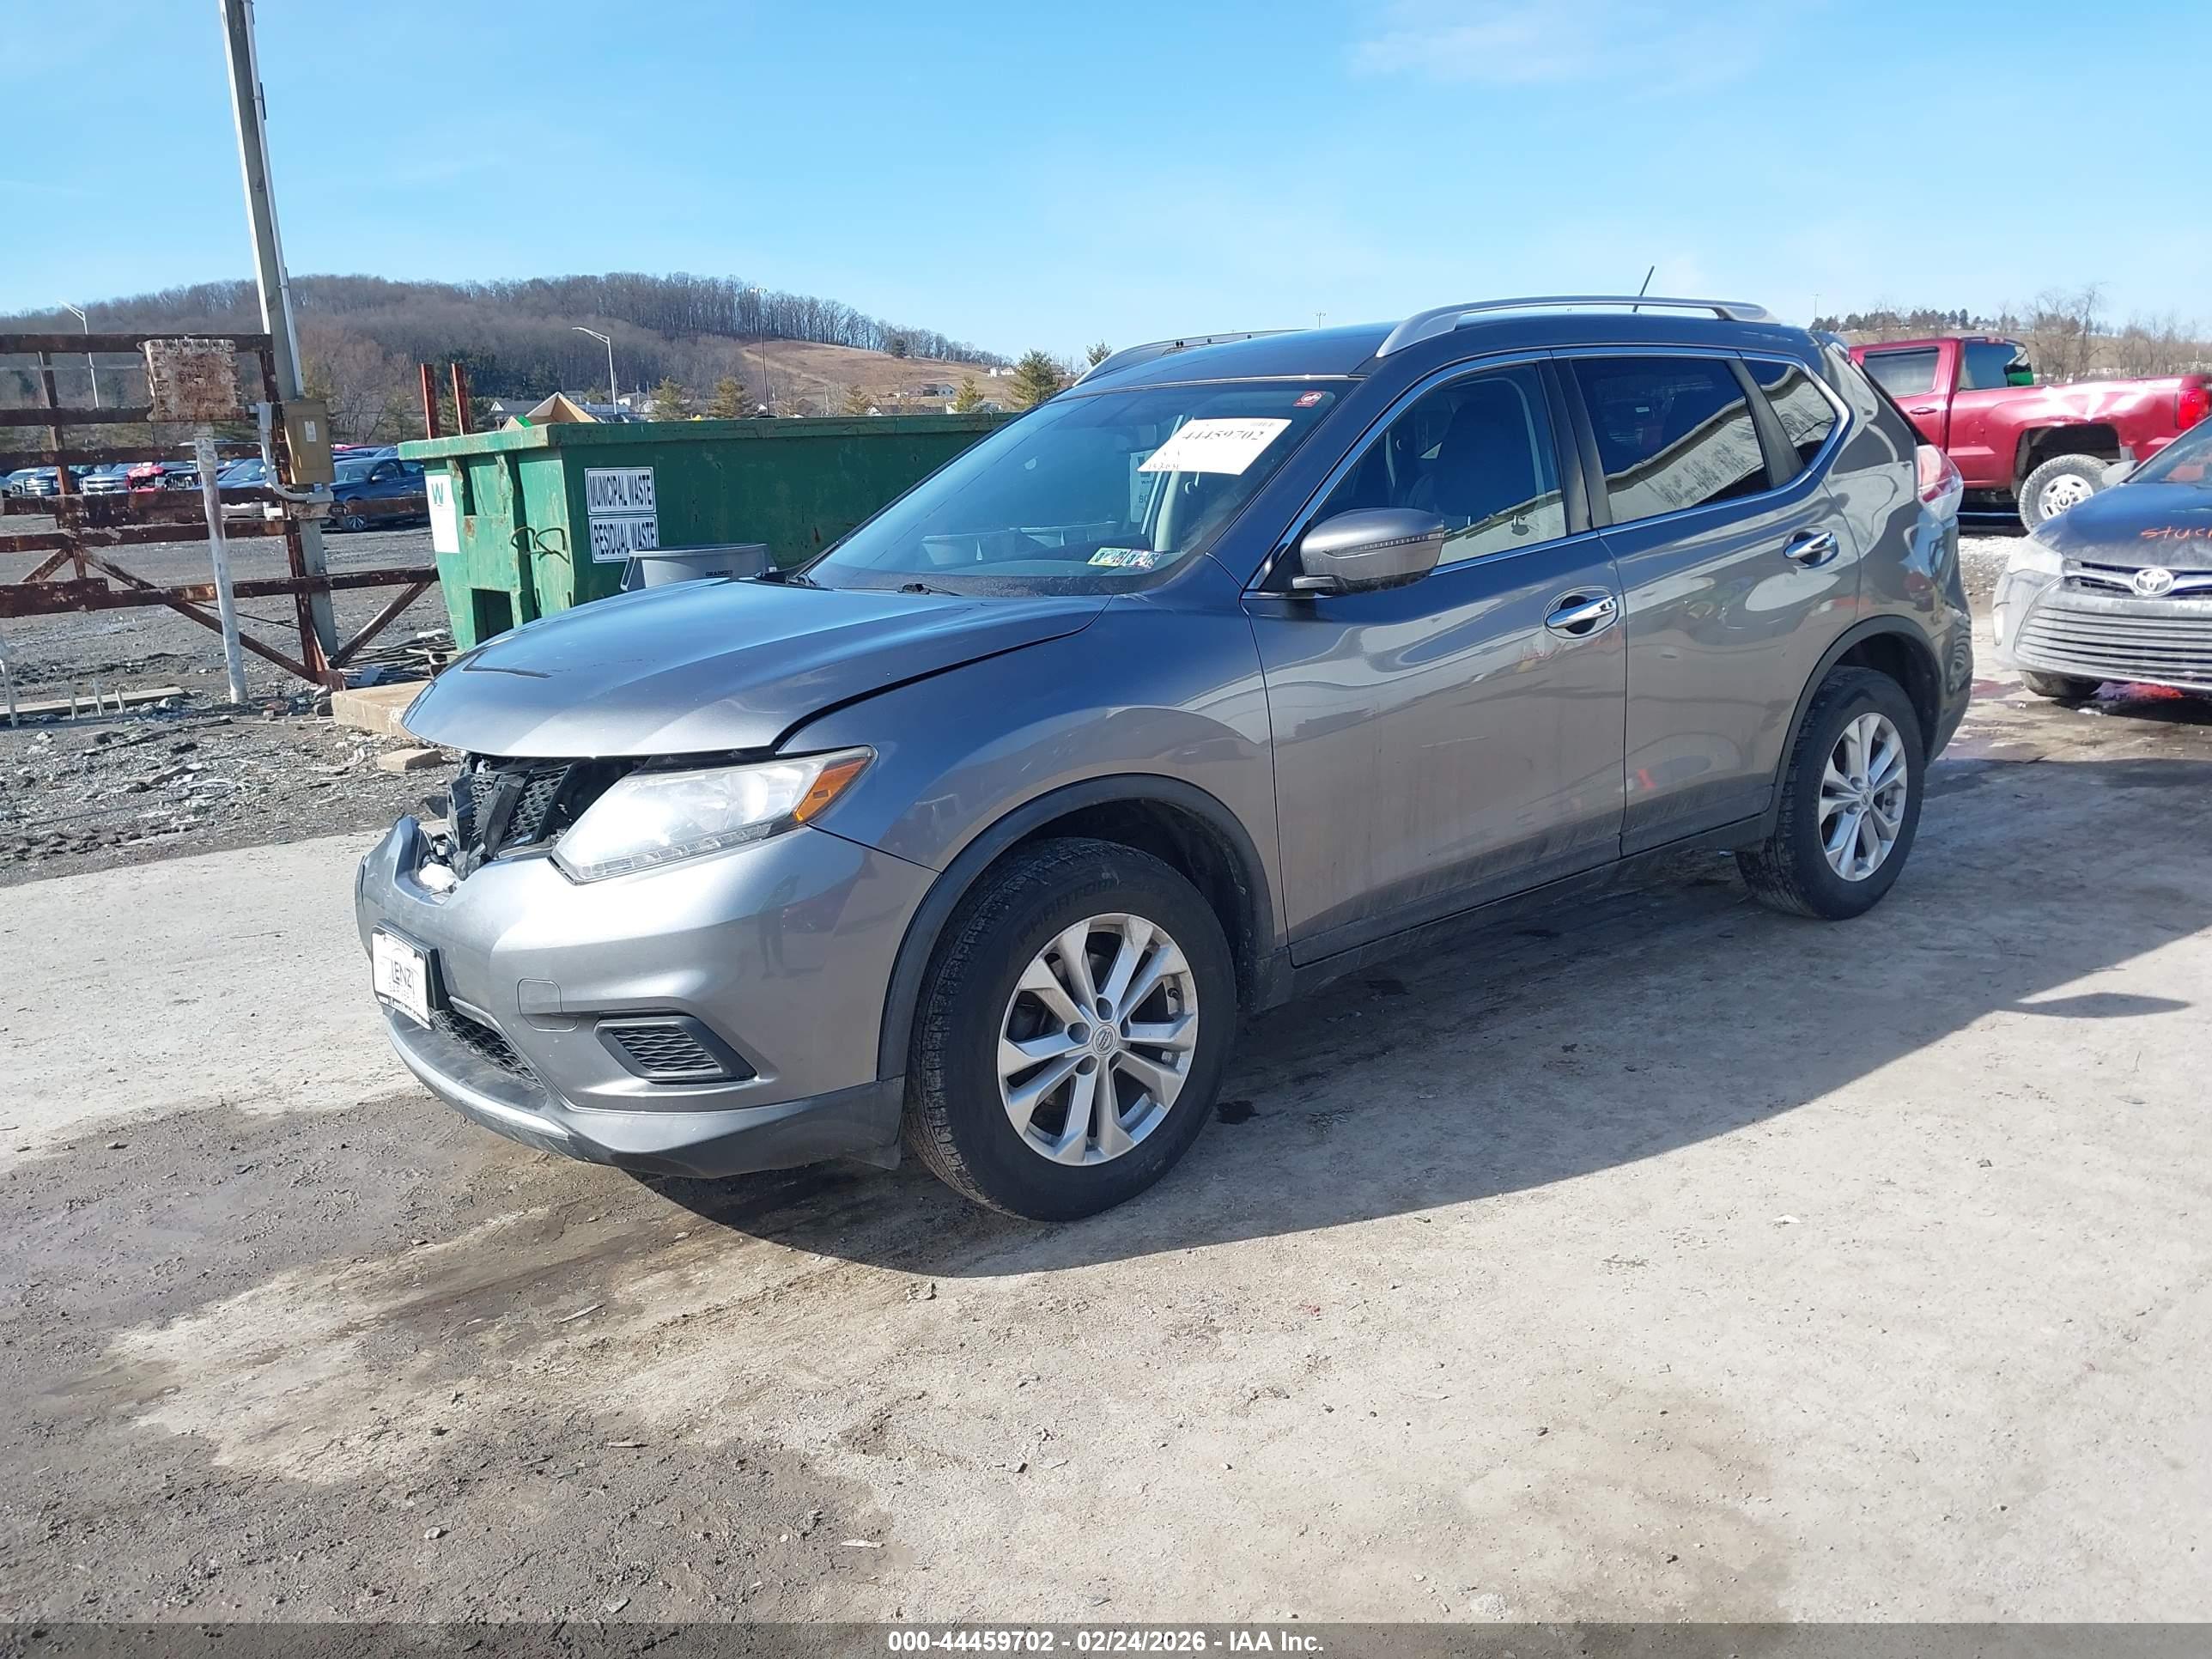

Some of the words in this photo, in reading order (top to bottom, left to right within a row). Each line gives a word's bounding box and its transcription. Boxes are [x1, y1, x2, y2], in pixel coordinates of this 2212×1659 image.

[589, 475, 628, 507] MUNICIPAL
[627, 474, 653, 507] WASTE
[593, 522, 630, 556] RESIDUAL
[629, 521, 655, 550] WASTE
